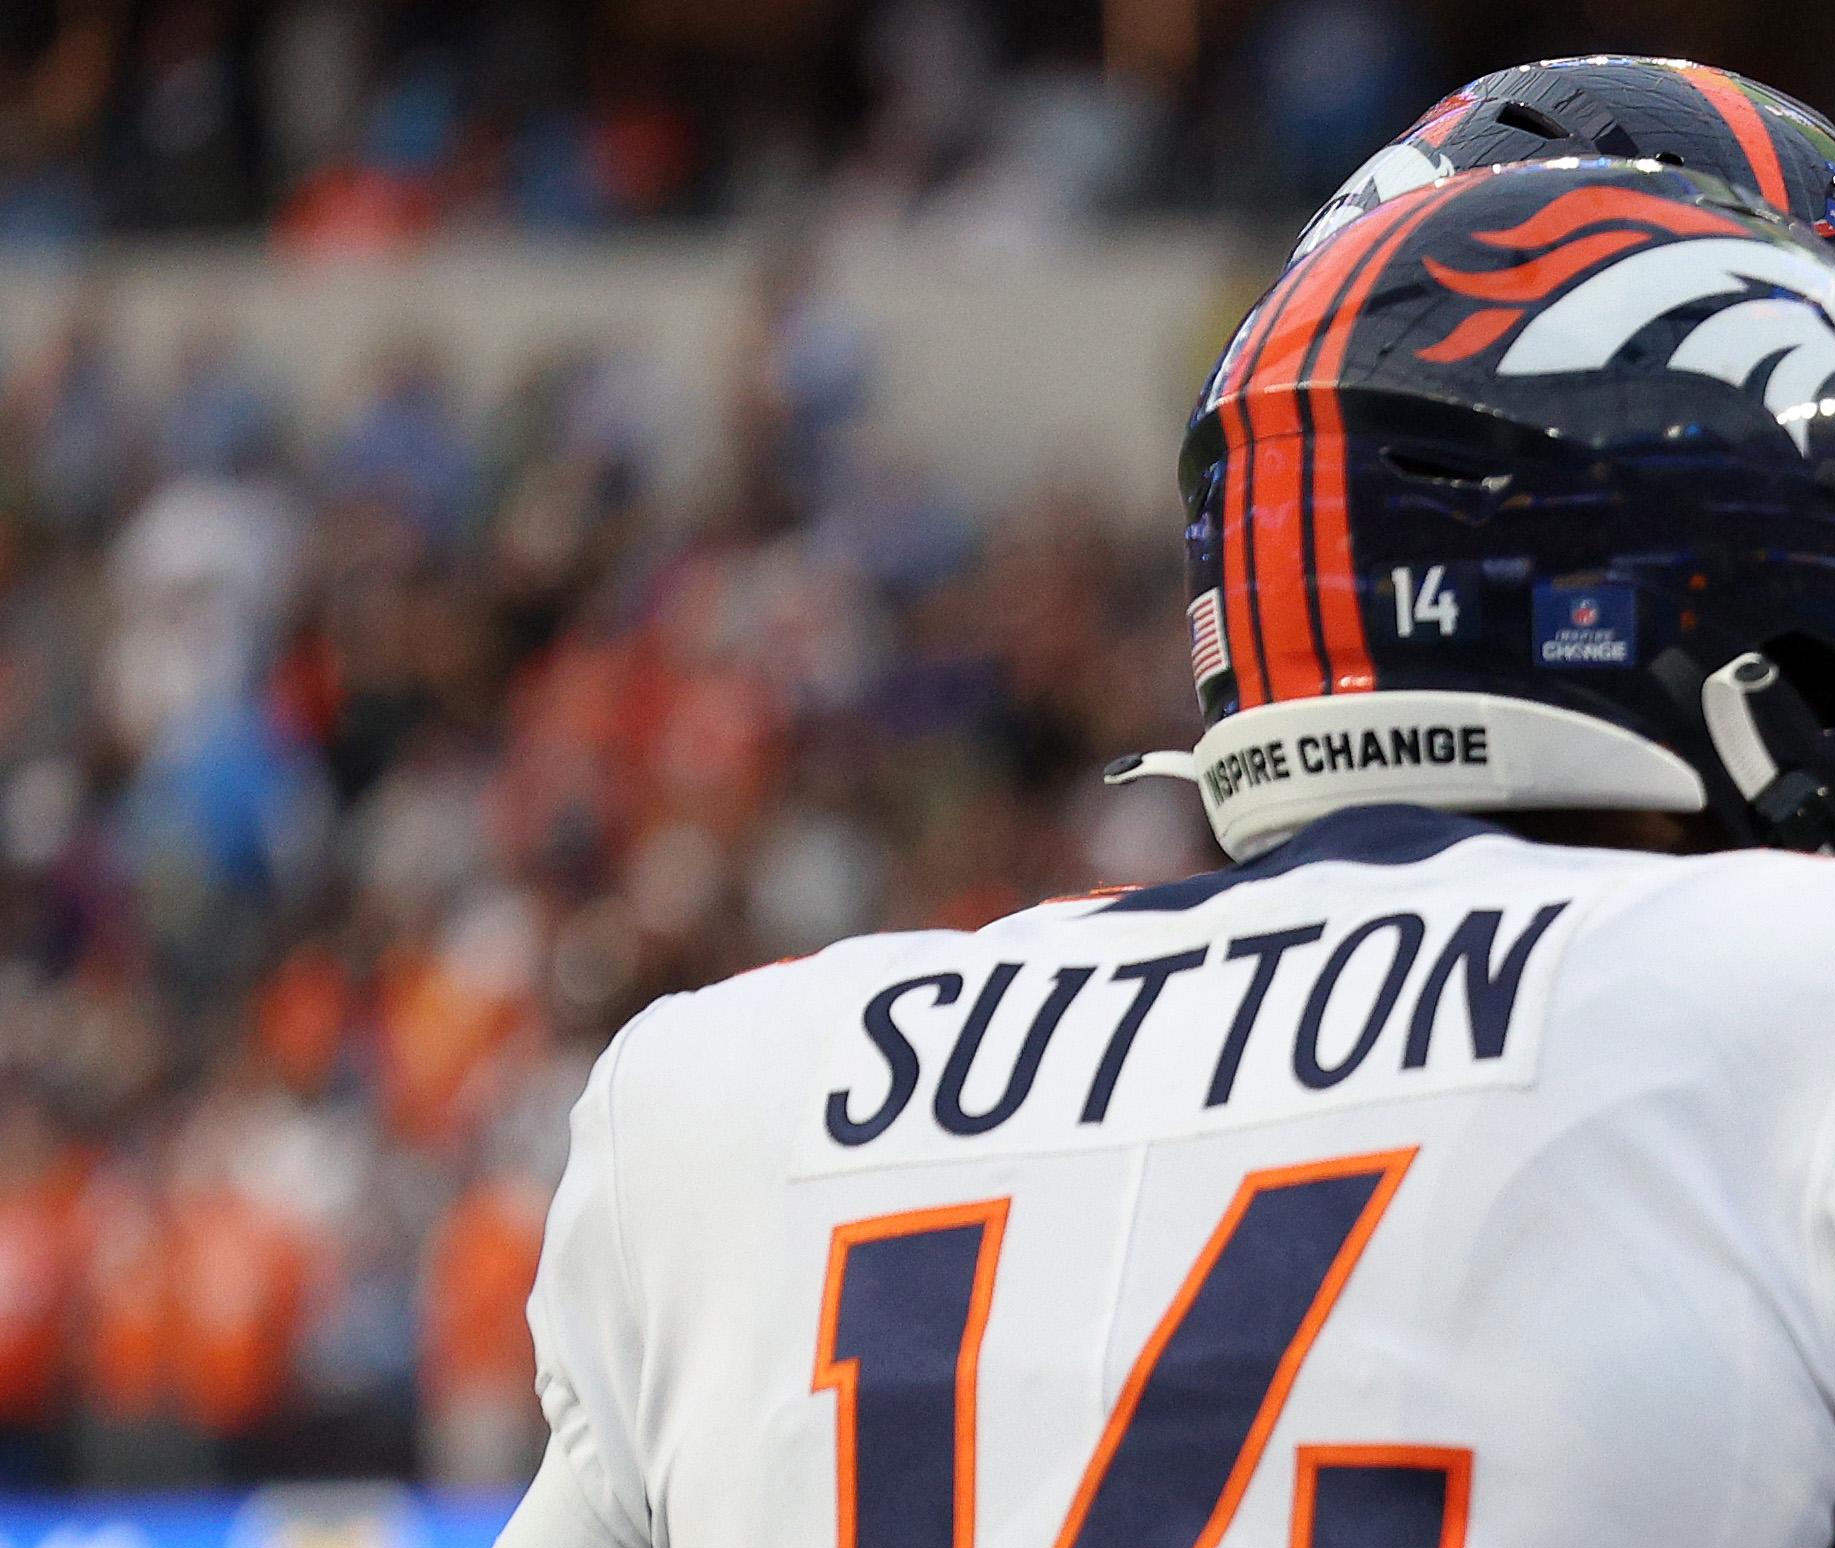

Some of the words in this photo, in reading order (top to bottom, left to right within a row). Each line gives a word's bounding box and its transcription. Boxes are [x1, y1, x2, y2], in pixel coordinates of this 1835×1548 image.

[1390, 565, 1460, 639] 14
[1541, 640, 1627, 662] CHANGE
[1203, 740, 1291, 808] NSPIRE
[1299, 726, 1488, 775] CHANGE
[824, 898, 1576, 1148] SUTTON
